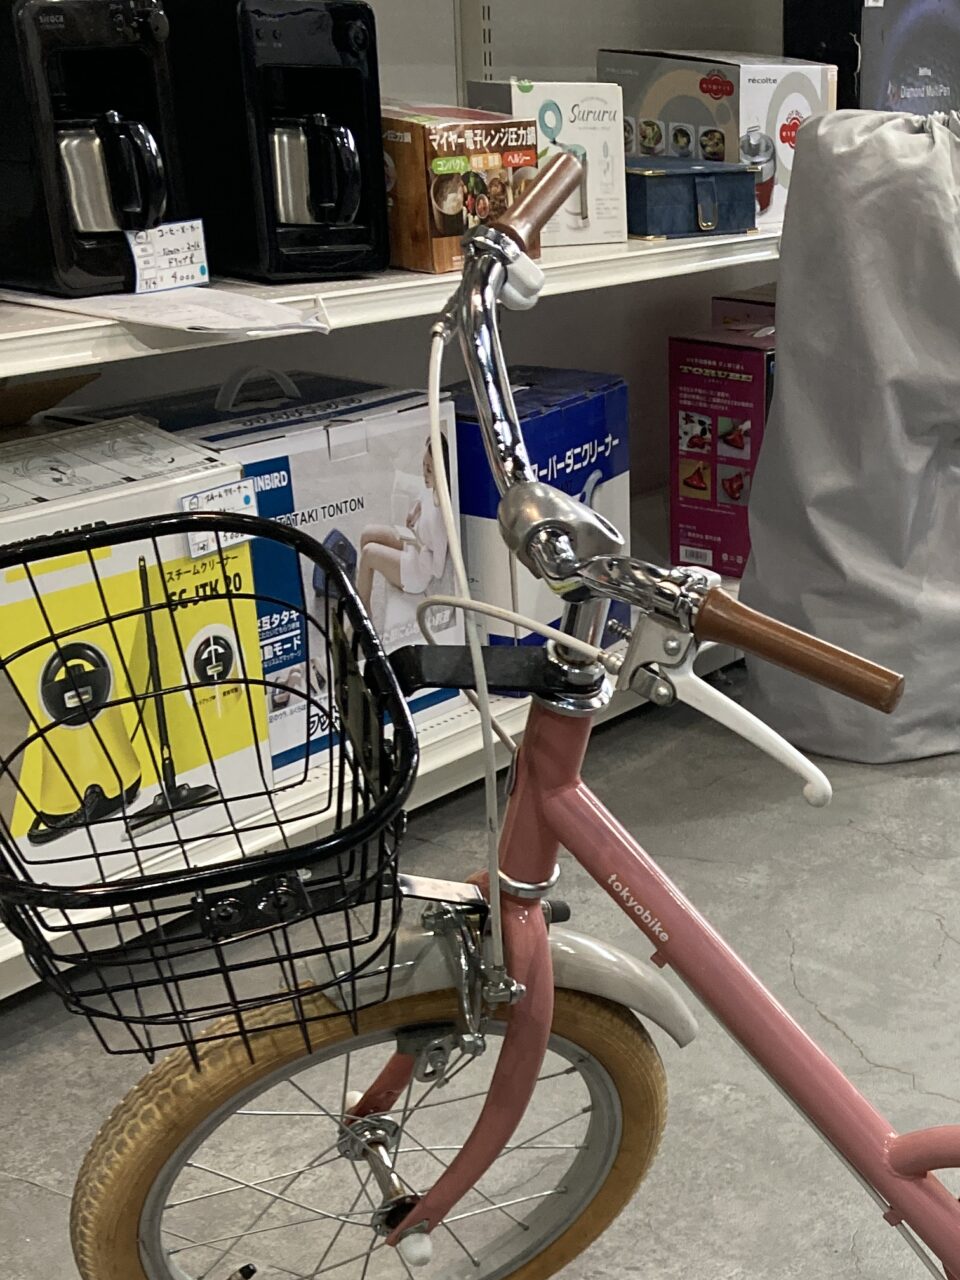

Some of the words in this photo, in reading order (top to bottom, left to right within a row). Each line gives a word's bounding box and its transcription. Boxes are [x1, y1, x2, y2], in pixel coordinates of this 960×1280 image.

[569, 103, 618, 124] Sururu
[428, 125, 537, 152] マイヤー電子レンジ圧力鍋
[253, 470, 289, 493] INBIRD
[320, 496, 365, 519] TONTON
[165, 555, 239, 584] スチームクリーナー
[262, 636, 302, 660] 動モード
[607, 873, 669, 942] tokyobike
